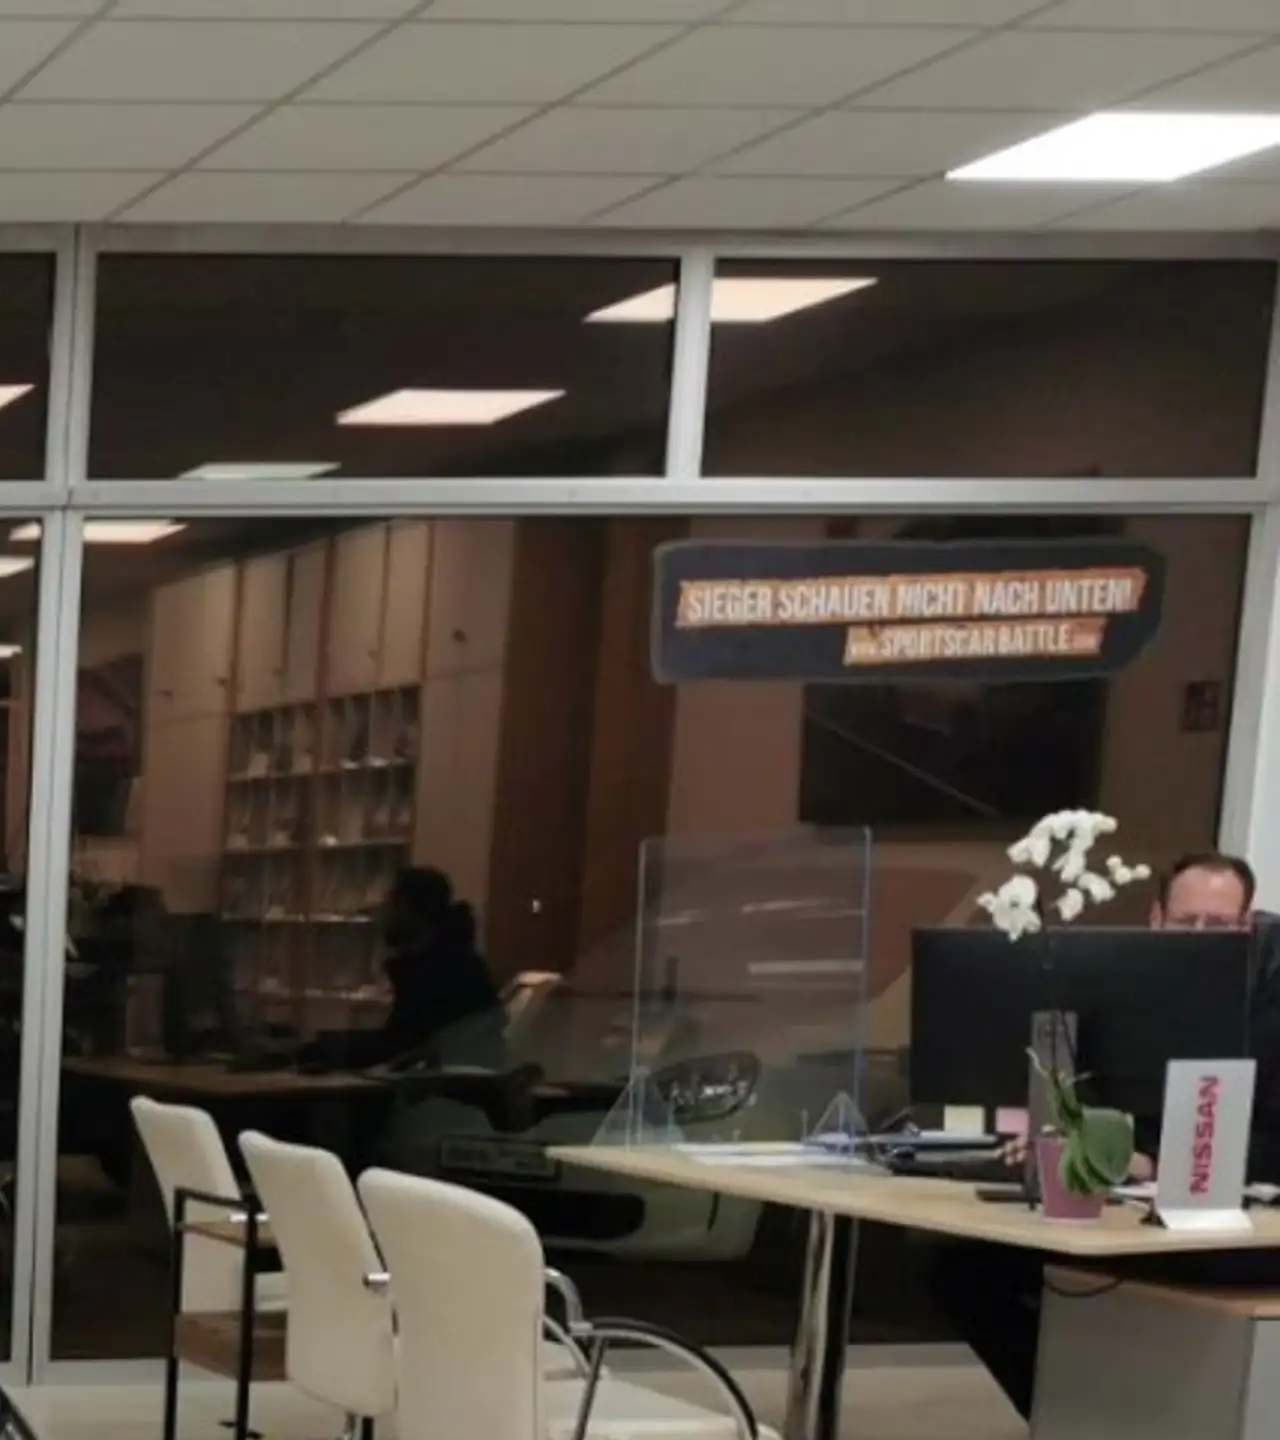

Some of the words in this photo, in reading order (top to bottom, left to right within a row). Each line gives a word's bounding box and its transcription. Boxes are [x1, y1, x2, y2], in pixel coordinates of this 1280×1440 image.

[686, 585, 773, 621] SIEGER
[777, 583, 890, 619] SCHAUEN
[896, 581, 965, 617] NICHT
[974, 580, 1040, 616] NACH
[1189, 1075, 1220, 1194] NISSAN
